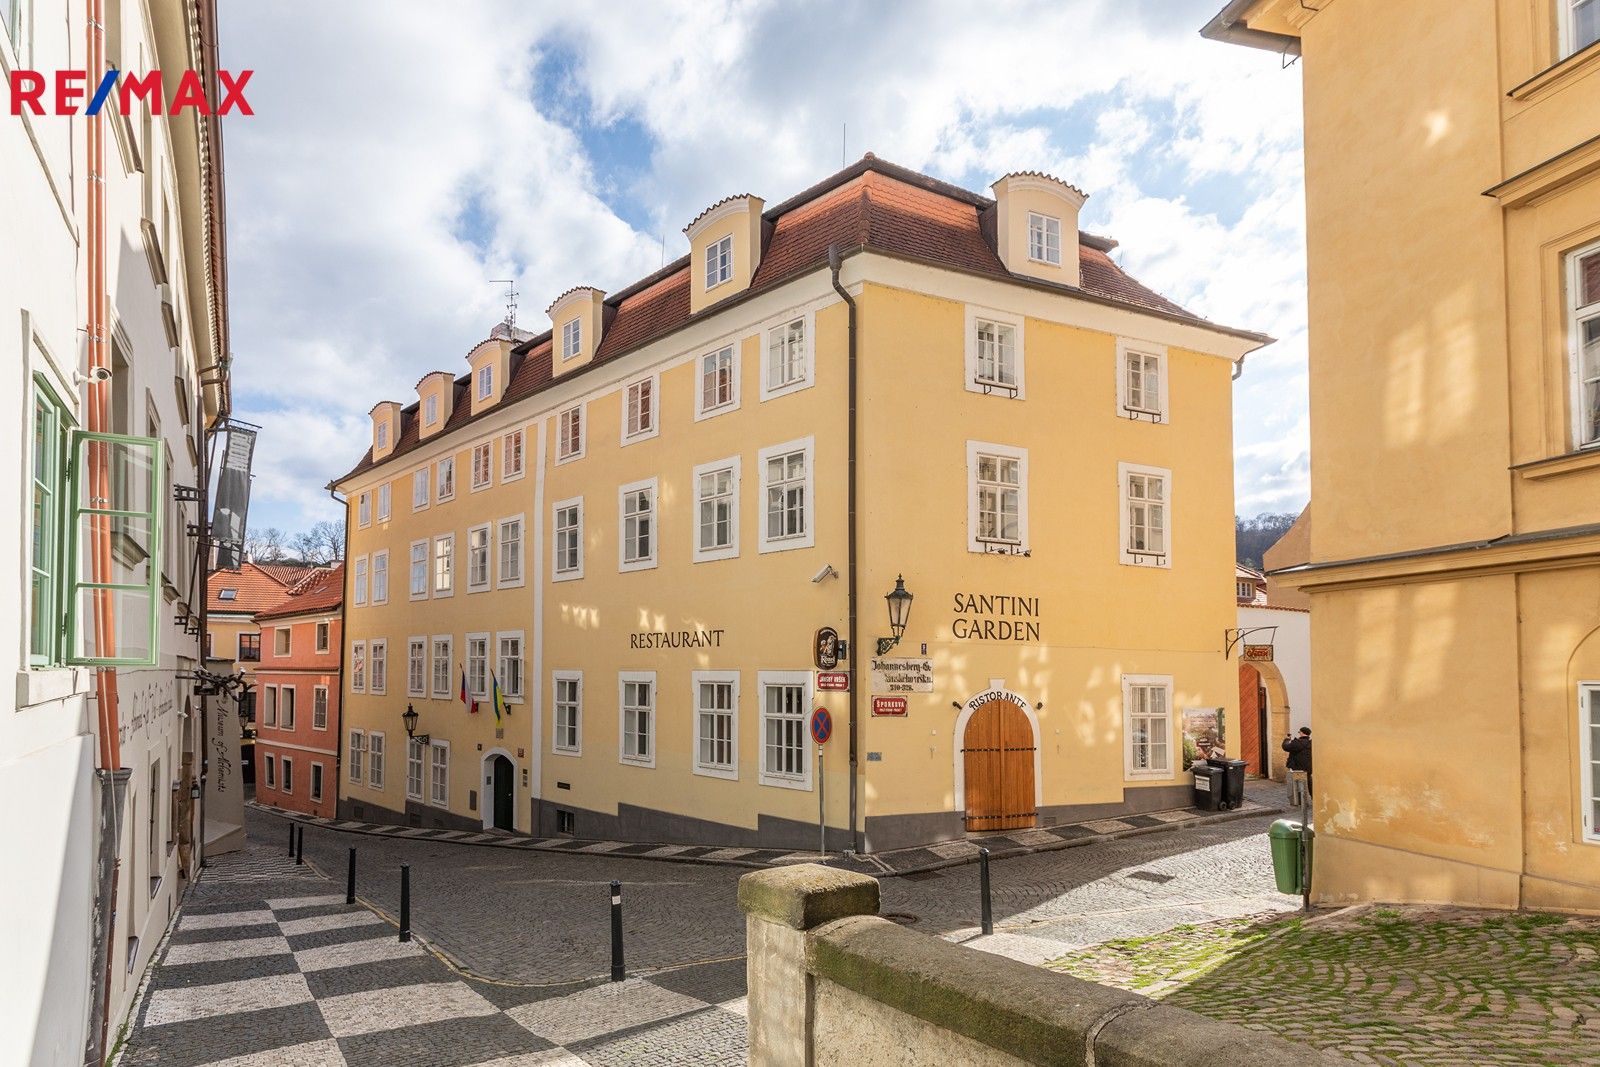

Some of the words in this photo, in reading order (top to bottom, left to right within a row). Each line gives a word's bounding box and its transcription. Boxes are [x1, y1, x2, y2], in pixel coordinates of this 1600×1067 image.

[953, 592, 1040, 617] SANTINI
[630, 629, 724, 649] RESTAURANT
[952, 618, 1040, 641] GARDEN
[968, 690, 1027, 711] RISTORANTE
